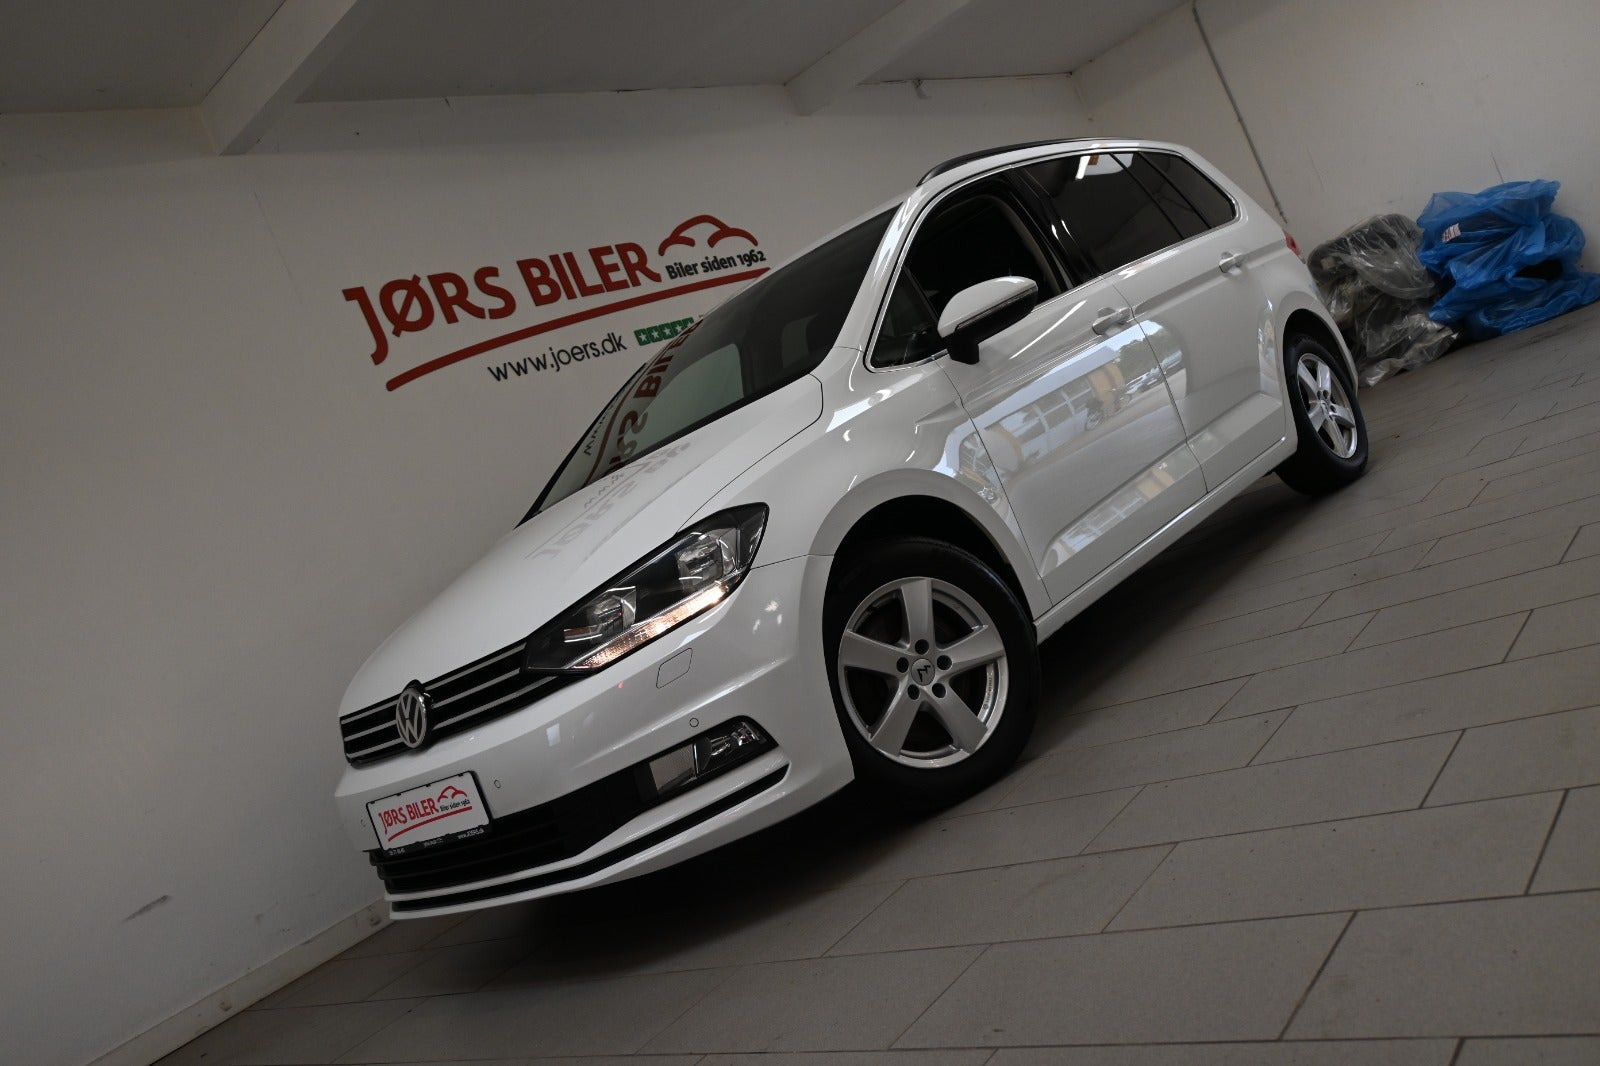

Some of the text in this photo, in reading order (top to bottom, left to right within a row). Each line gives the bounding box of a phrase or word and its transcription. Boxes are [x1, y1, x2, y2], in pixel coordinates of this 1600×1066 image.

[665, 249, 767, 279] Biler siden 1962
[342, 242, 662, 365] JØRS BILER
[487, 332, 627, 382] www.joers.dk
[378, 797, 439, 835] JØRS BILER
